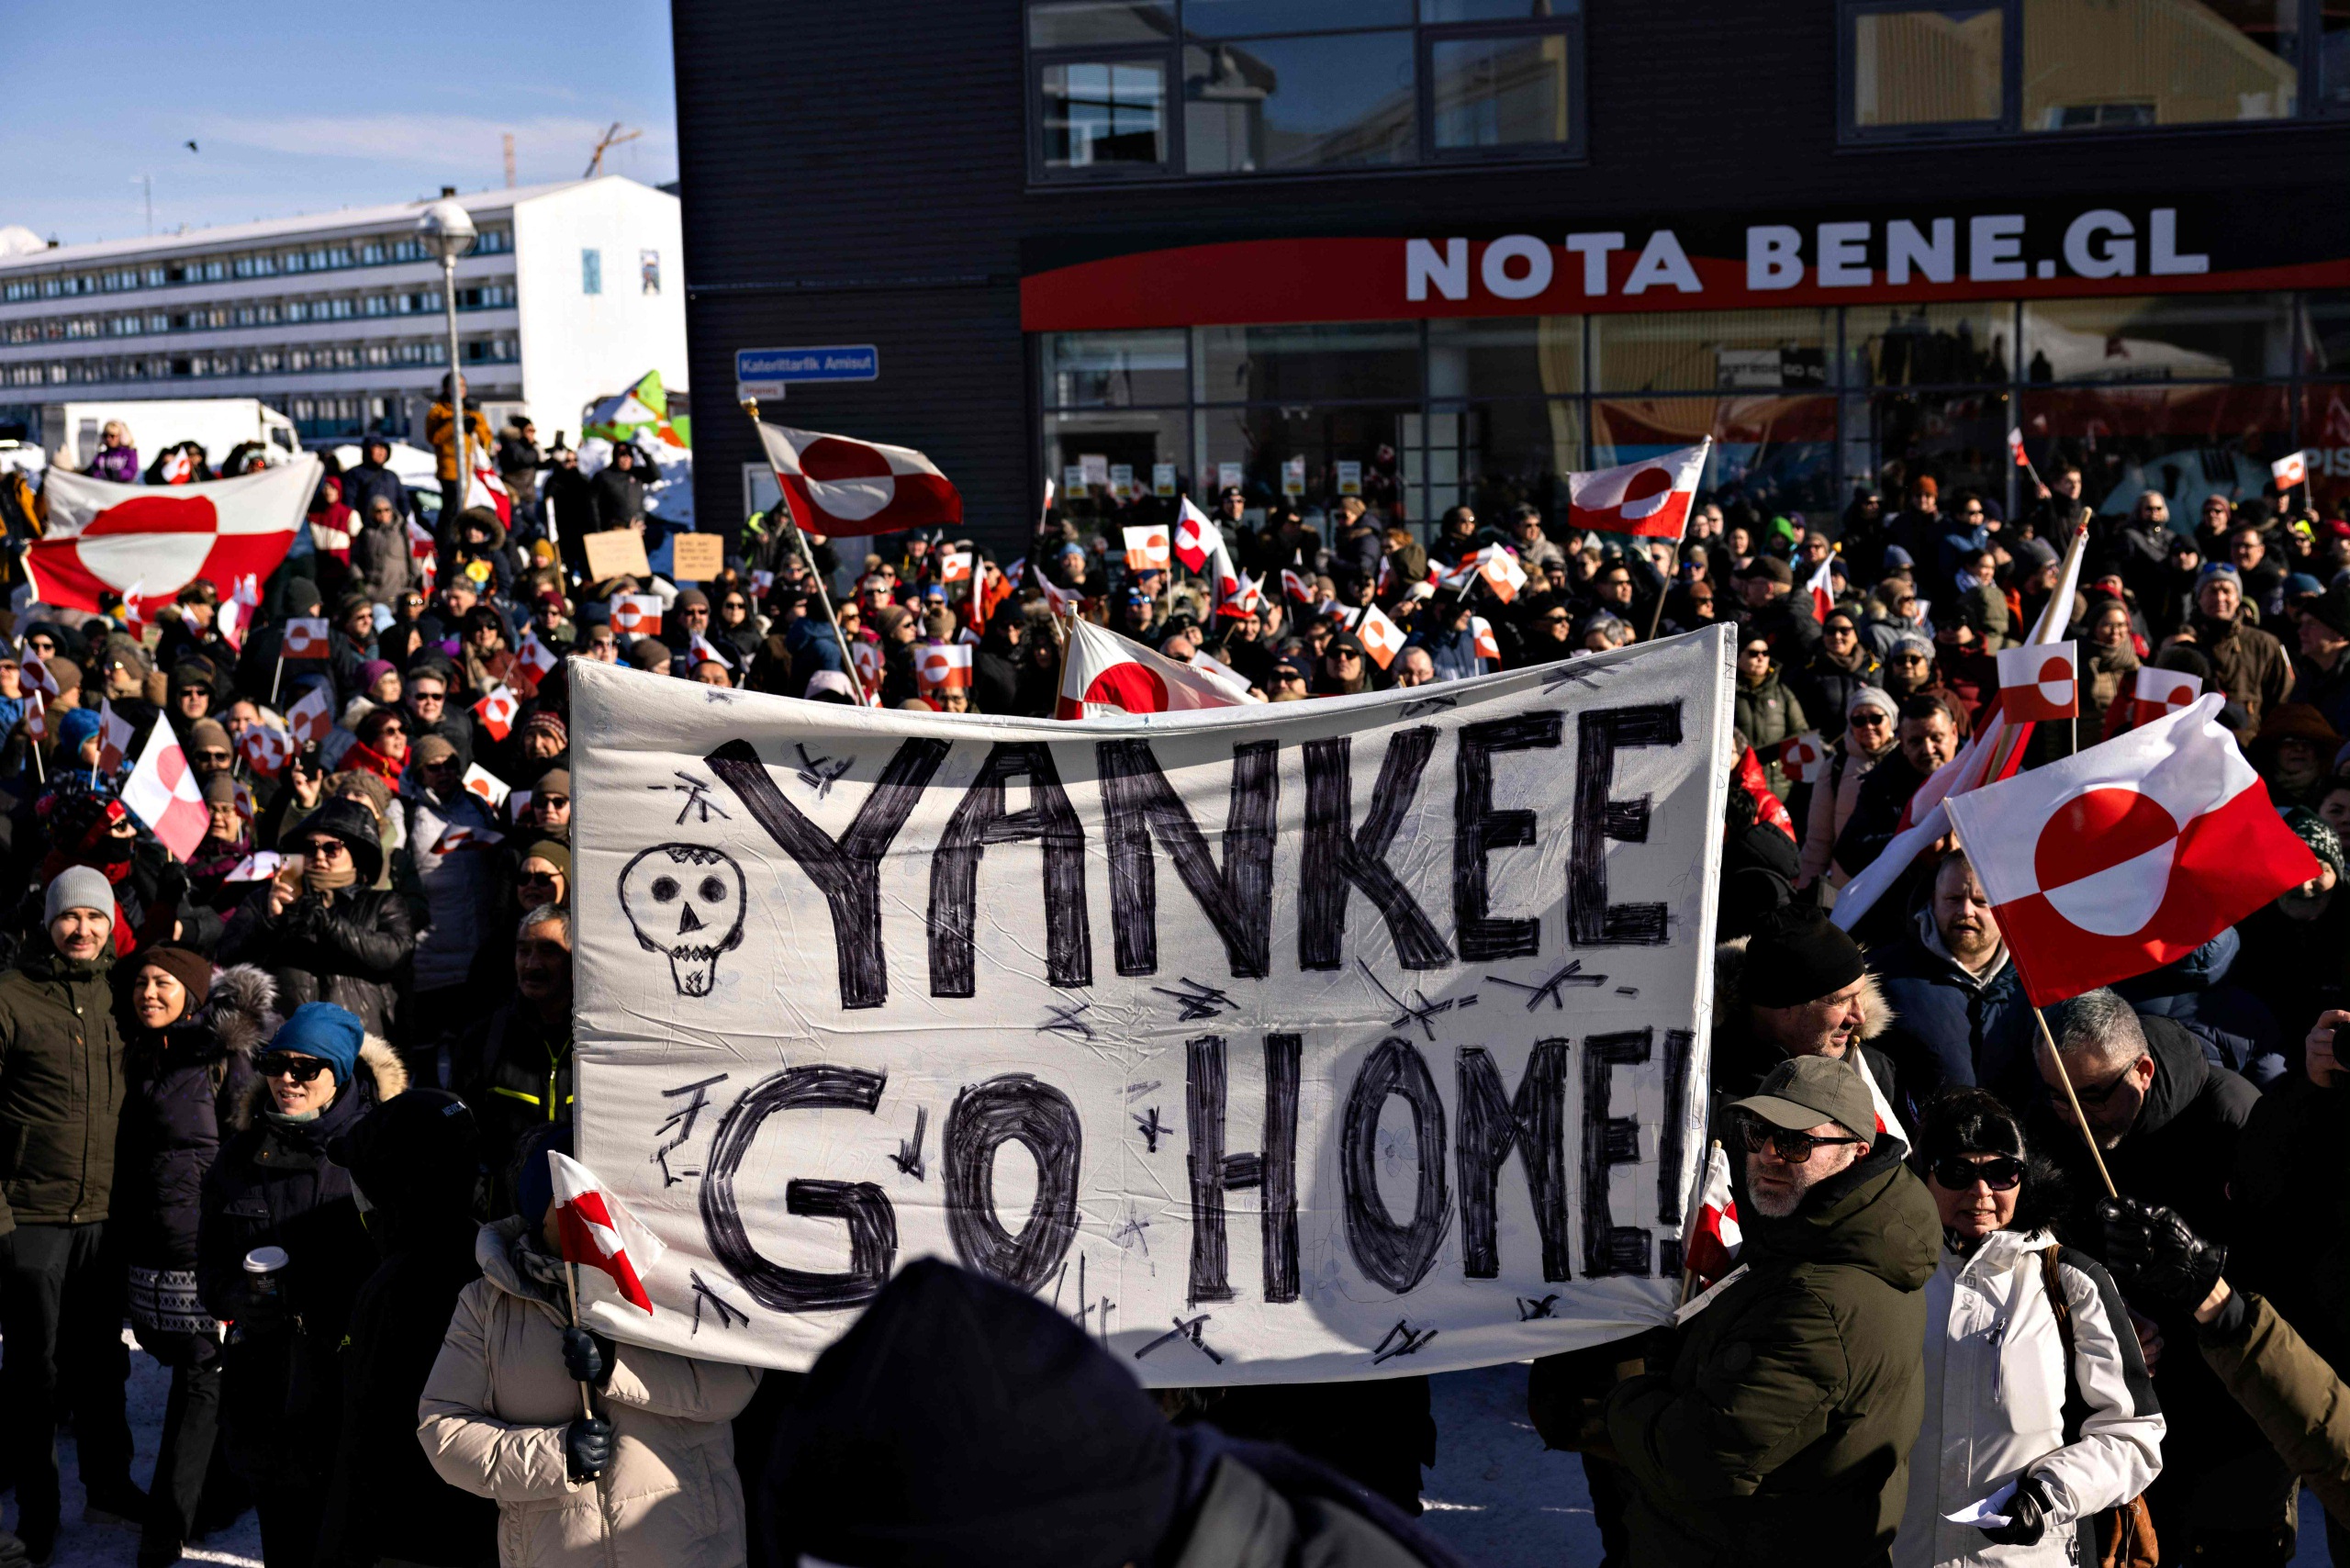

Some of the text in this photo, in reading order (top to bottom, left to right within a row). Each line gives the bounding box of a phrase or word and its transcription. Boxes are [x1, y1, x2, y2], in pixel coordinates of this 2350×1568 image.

[1404, 207, 2210, 302] NOTA BENE.GL
[703, 699, 1683, 1010] YANKEE
[699, 1025, 1695, 1314] GO HOME!
